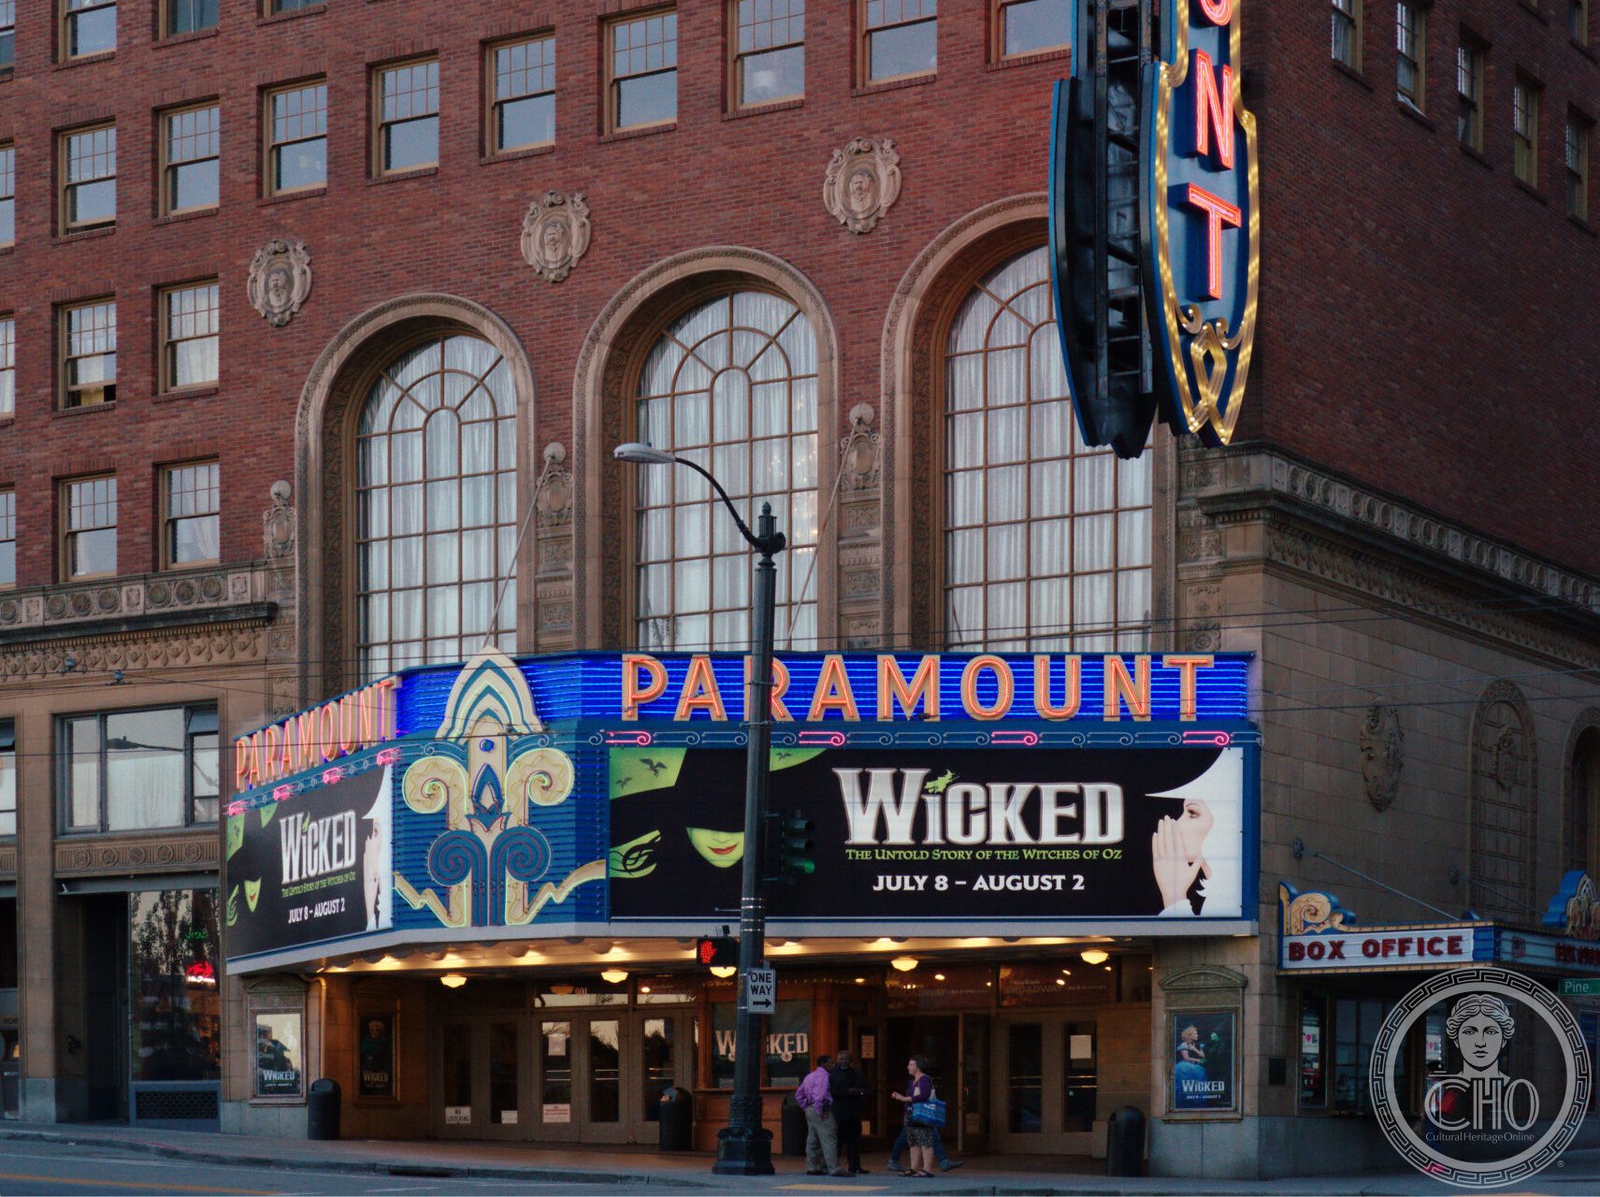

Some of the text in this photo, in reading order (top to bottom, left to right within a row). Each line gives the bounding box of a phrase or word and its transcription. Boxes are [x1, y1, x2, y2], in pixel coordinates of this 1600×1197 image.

[620, 653, 1215, 722] PARAMOUNT
[236, 676, 402, 793] PARAMOUNT
[845, 848, 1123, 861] THE UNTOLD STORY OF THE WITCHES OF OZ
[873, 875, 928, 891] JULY
[934, 875, 949, 891] 8
[972, 875, 1066, 891] AUGUST
[1071, 875, 1085, 891] 2
[288, 907, 304, 923] JULY
[304, 906, 309, 920] 8
[314, 899, 340, 918] AUGUST
[341, 898, 345, 912] 2
[1288, 935, 1464, 961] BOX OFFICE
[750, 973, 772, 983] ONE
[750, 985, 772, 996] WAY
[1564, 981, 1590, 993] Pine
